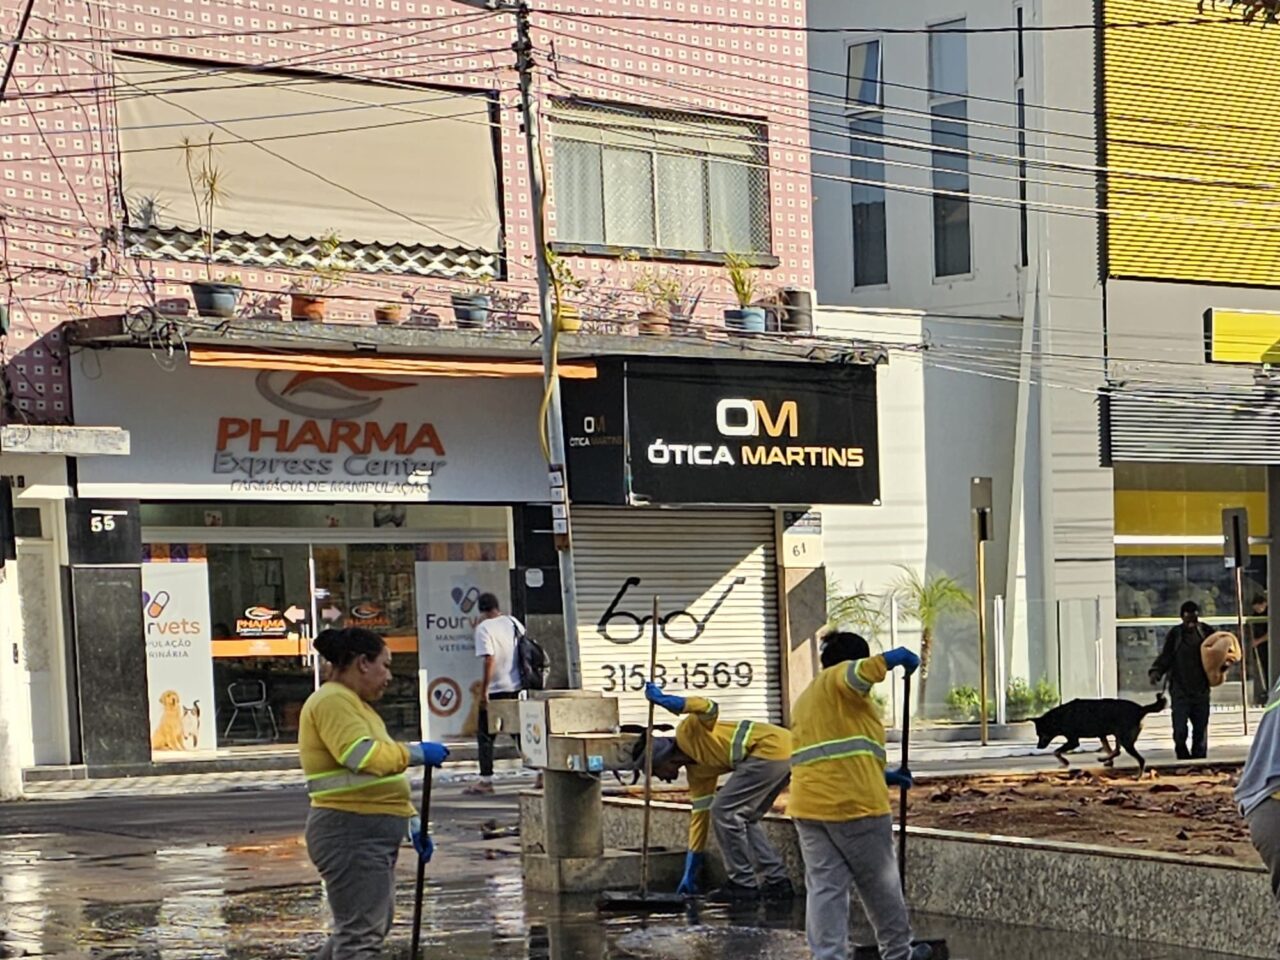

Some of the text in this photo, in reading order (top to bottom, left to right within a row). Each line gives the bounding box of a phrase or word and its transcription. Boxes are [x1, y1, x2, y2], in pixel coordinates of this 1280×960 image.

[716, 398, 798, 438] OM
[216, 417, 446, 456] PHARMA
[212, 452, 448, 478] Express Center
[647, 438, 864, 467] ÓTICA MARTINS
[230, 478, 432, 497] FARMÁCIA DE MANIPULAÇÃO
[91, 515, 115, 532] 55
[792, 542, 806, 557] 61
